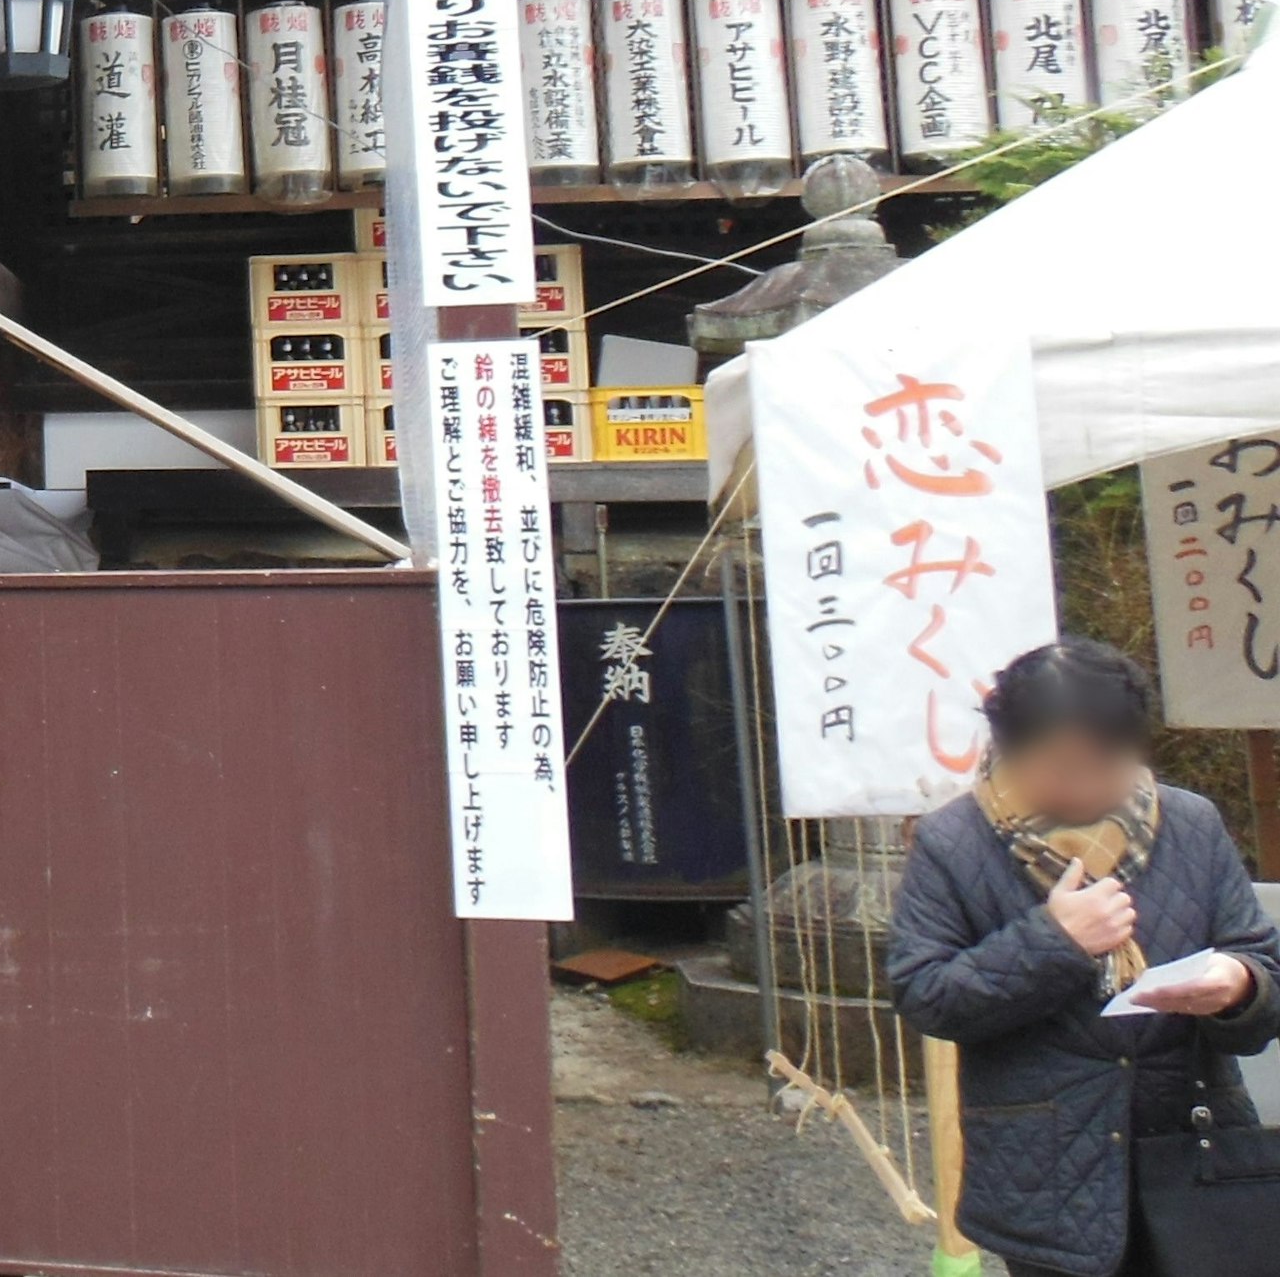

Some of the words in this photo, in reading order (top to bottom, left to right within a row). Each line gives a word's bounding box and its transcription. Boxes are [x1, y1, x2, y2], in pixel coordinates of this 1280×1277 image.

[268, 41, 310, 147] 月桂冠
[725, 22, 762, 146] アサヒビール
[912, 10, 952, 139] VCC企画
[269, 297, 340, 310] アサヒビール
[273, 368, 343, 380] アサヒビール
[276, 439, 347, 452] アサヒビール
[616, 427, 686, 446] KIRIN
[474, 354, 512, 749] 鈴の緒を撤去致しております
[600, 622, 653, 703] 奉納
